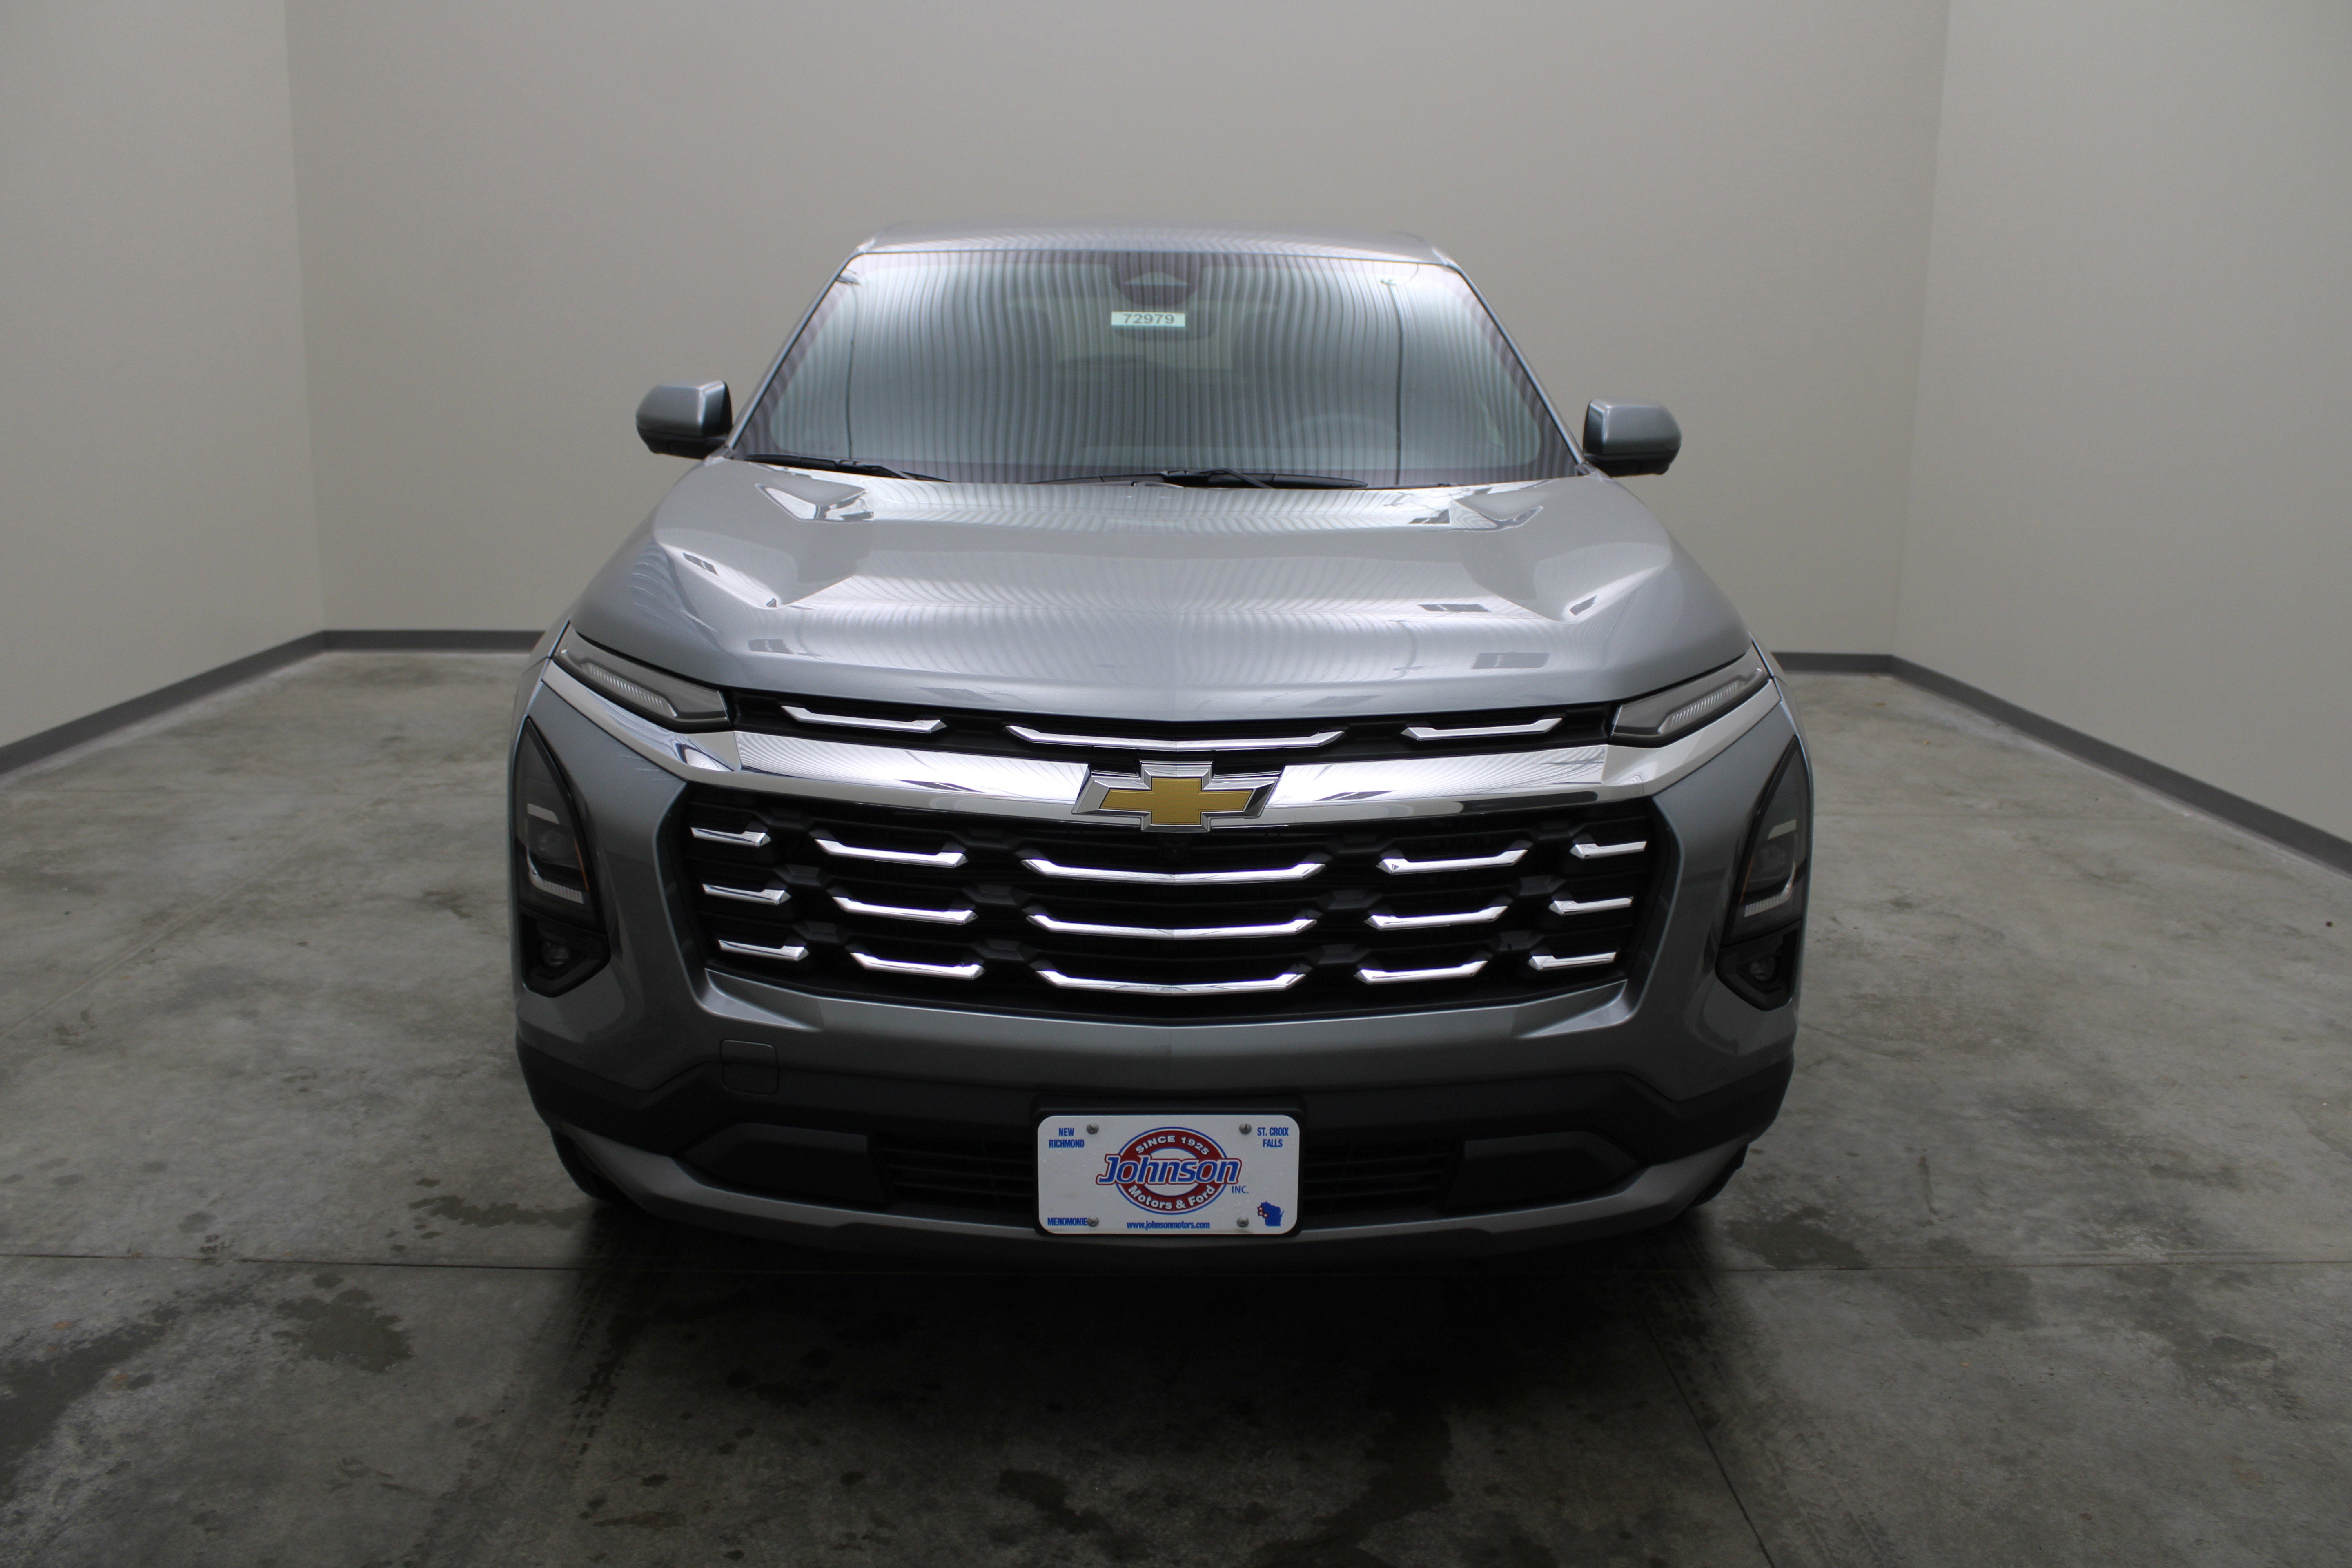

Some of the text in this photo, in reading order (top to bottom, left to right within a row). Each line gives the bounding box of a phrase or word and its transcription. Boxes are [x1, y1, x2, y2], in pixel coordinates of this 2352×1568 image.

[1123, 313, 1174, 324] 72979
[1059, 1128, 1074, 1136] NEW
[1257, 1127, 1289, 1136] ST. CROIX
[1049, 1139, 1085, 1148] RICHMOND
[1136, 1135, 1209, 1155] SINCE 1925
[1263, 1139, 1283, 1148] FALLS
[1097, 1155, 1241, 1184] Johnson
[1232, 1186, 1249, 1194] INC.
[1128, 1185, 1215, 1210] Motors & Ford
[1047, 1217, 1088, 1226] MENOMONIE
[1127, 1221, 1210, 1230] www.johnsonmotors.com
